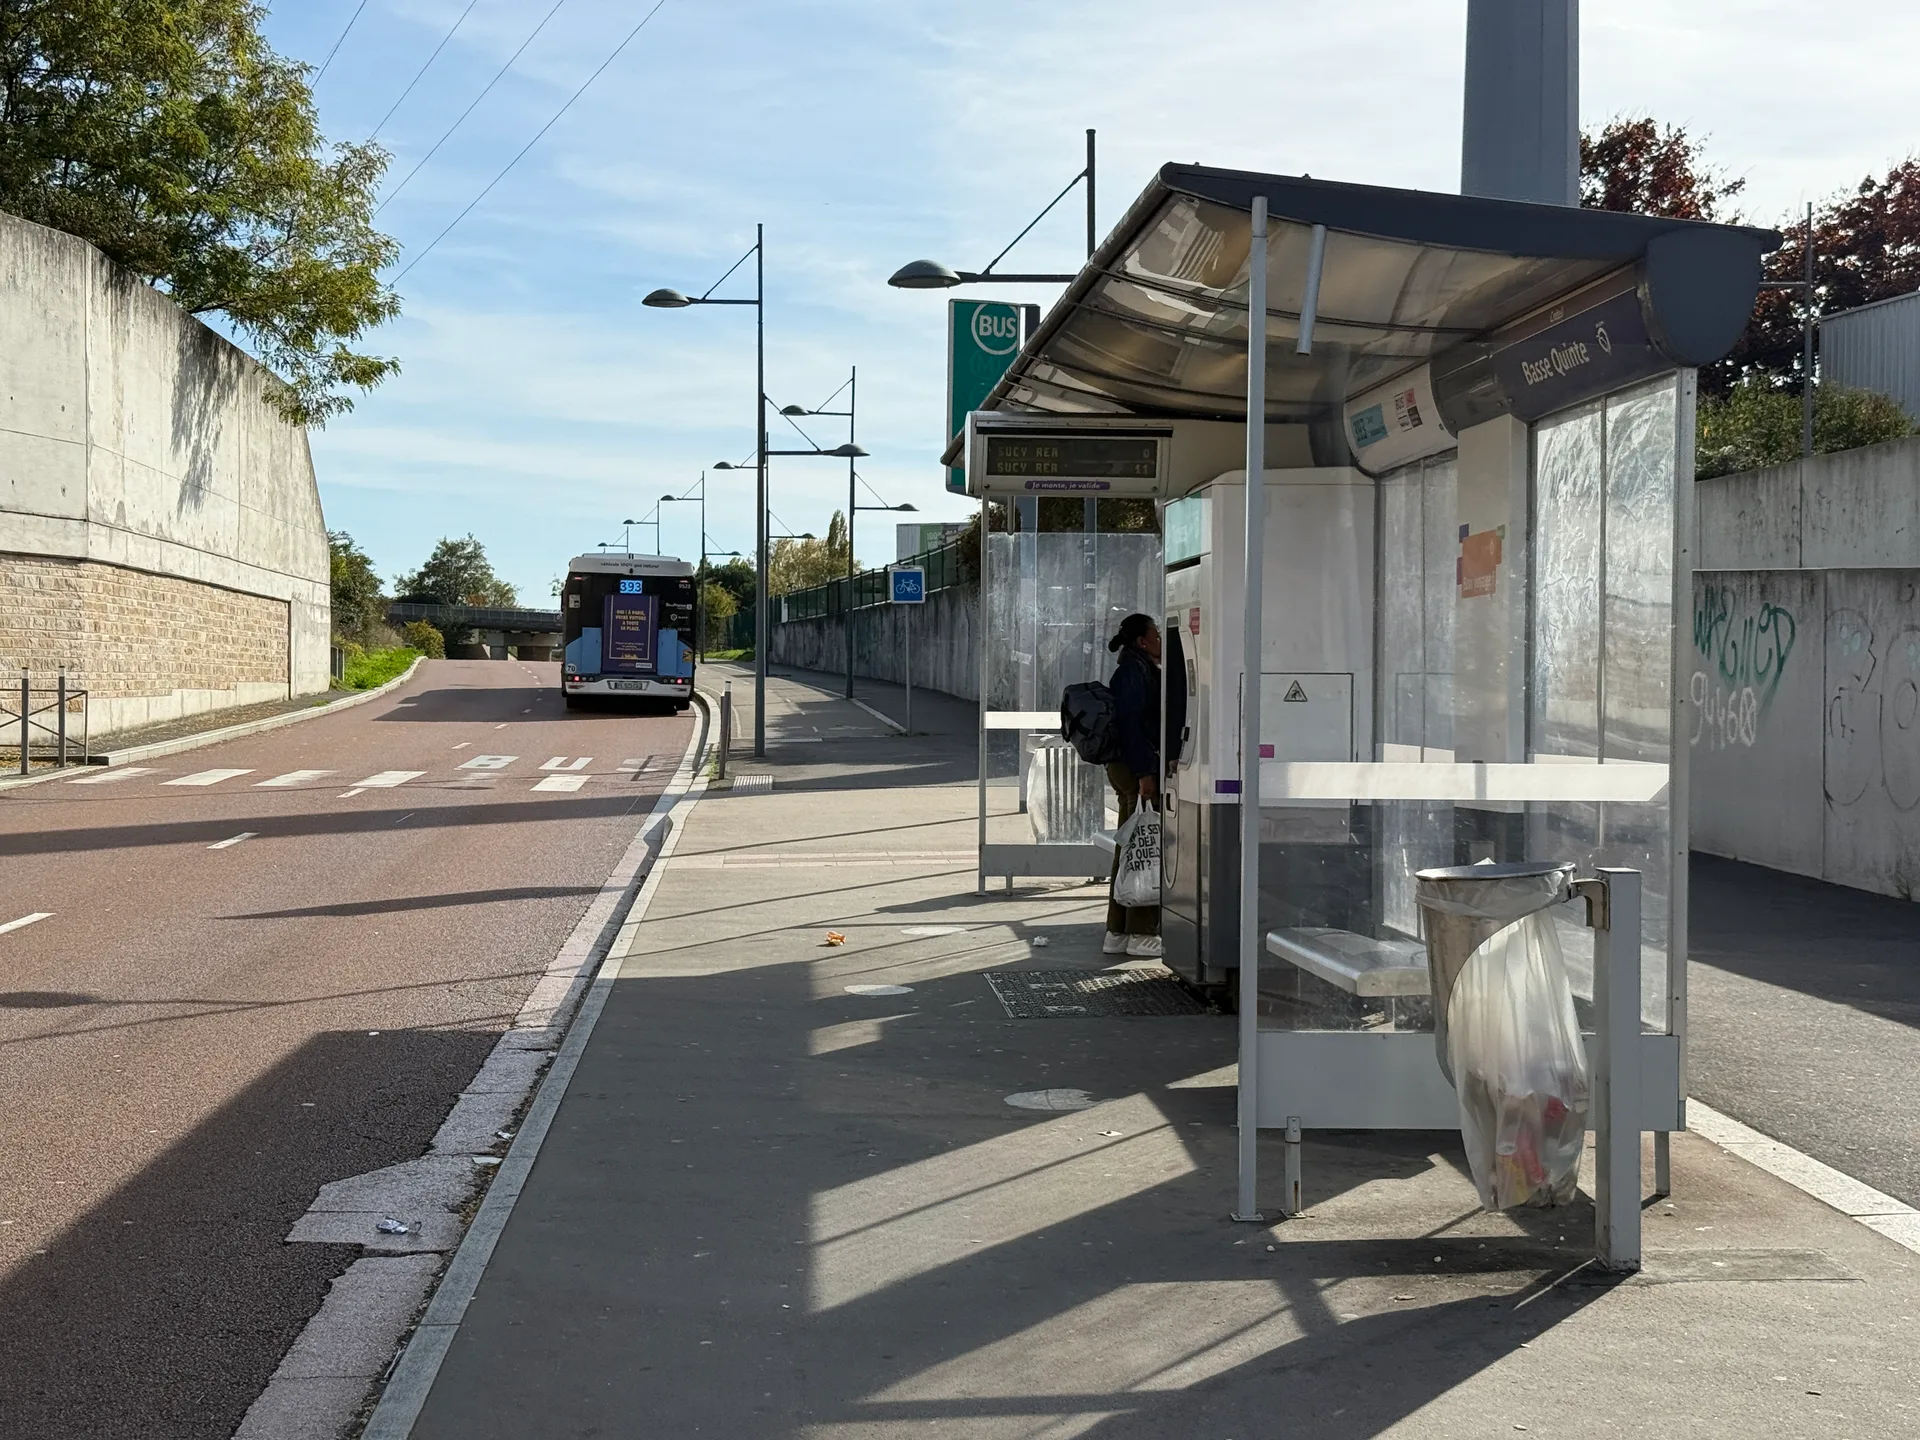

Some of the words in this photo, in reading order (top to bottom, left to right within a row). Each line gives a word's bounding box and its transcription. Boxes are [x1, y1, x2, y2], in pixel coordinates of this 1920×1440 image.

[979, 315, 1017, 338] BUS
[1521, 357, 1554, 386] Basse
[1550, 341, 1591, 377] Quinte
[998, 446, 1027, 458] SUCY
[997, 462, 1027, 473] SUCY
[1134, 464, 1149, 475] 11
[1032, 482, 1040, 490] Je
[1069, 482, 1077, 490] je
[1077, 482, 1101, 490] valide
[620, 581, 642, 593] 393
